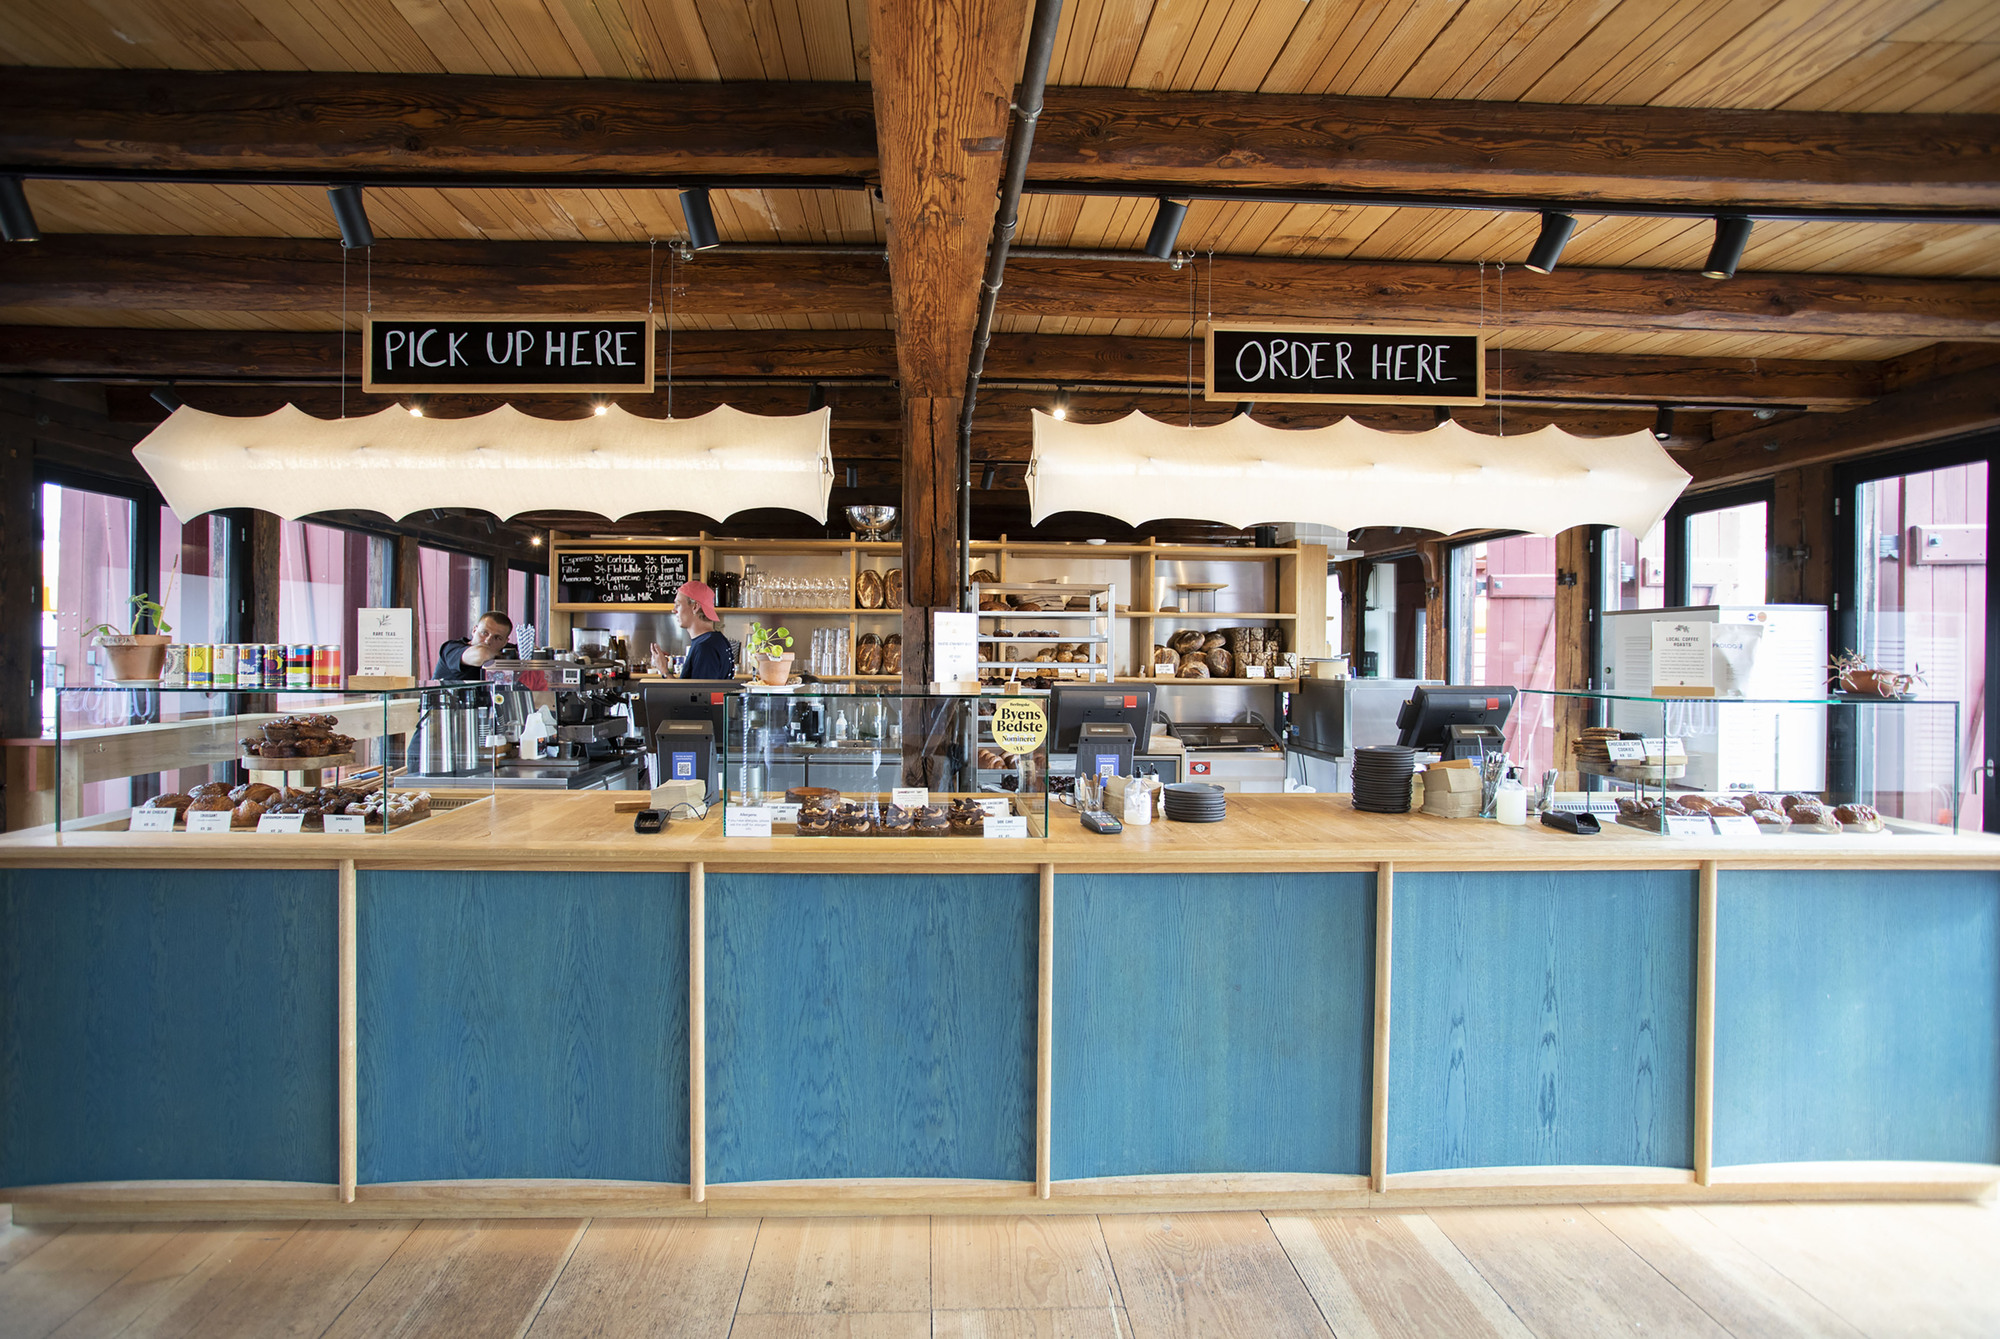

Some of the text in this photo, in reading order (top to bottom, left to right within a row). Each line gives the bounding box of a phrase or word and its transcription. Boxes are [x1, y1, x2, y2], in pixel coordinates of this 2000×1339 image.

[385, 328, 637, 370] PICK UP HERE
[1235, 339, 1458, 384] ORDER HERE
[561, 556, 592, 566] Espresso
[607, 554, 636, 564] Cortado
[660, 555, 683, 564] Choose
[607, 564, 621, 573] Flat
[623, 564, 642, 573] White
[675, 564, 684, 573] all
[561, 574, 592, 582] Americano
[606, 573, 641, 584] Cappuccino
[675, 572, 686, 582] tea
[607, 582, 630, 591] Latte
[658, 580, 684, 588] selection
[660, 587, 670, 596] for
[602, 592, 615, 603] Oat
[637, 591, 653, 602] Milk
[1001, 708, 1041, 722] Byens
[996, 720, 1043, 732] Bedste
[1002, 735, 1036, 743] Nomineret
